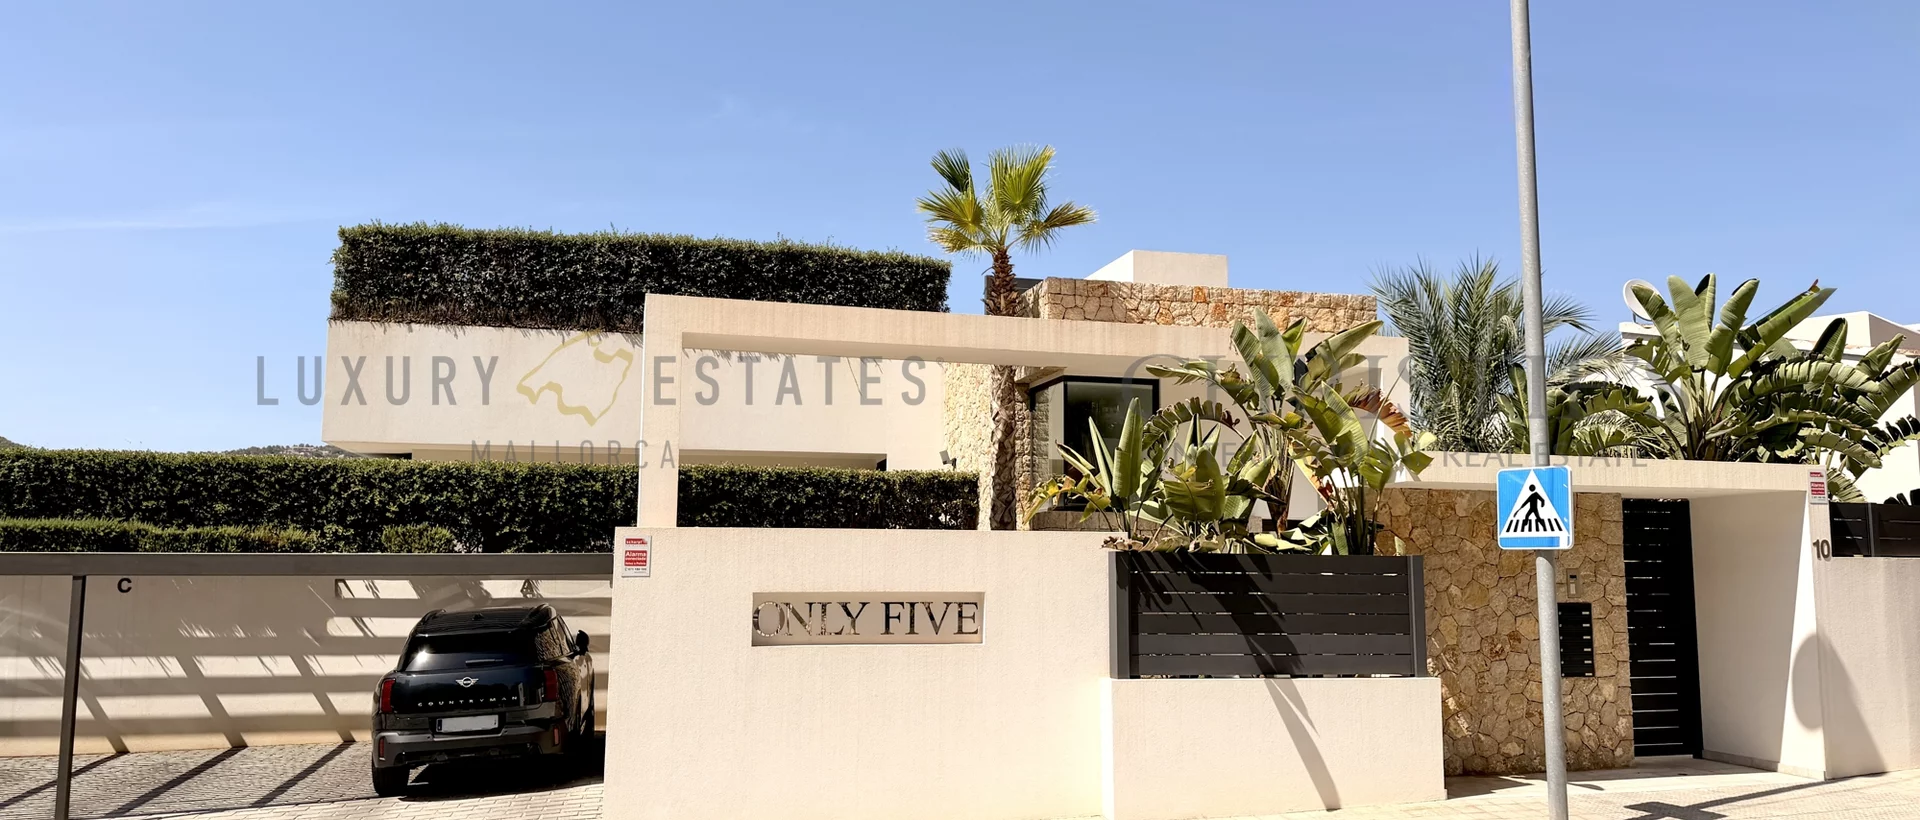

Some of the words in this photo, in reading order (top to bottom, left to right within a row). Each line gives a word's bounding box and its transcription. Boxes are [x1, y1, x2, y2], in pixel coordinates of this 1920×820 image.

[1813, 539, 1831, 560] 10
[117, 577, 132, 593] C
[752, 601, 870, 638] ONLY
[880, 601, 981, 636] FIVE
[417, 696, 518, 707] COUNTRYMAN
